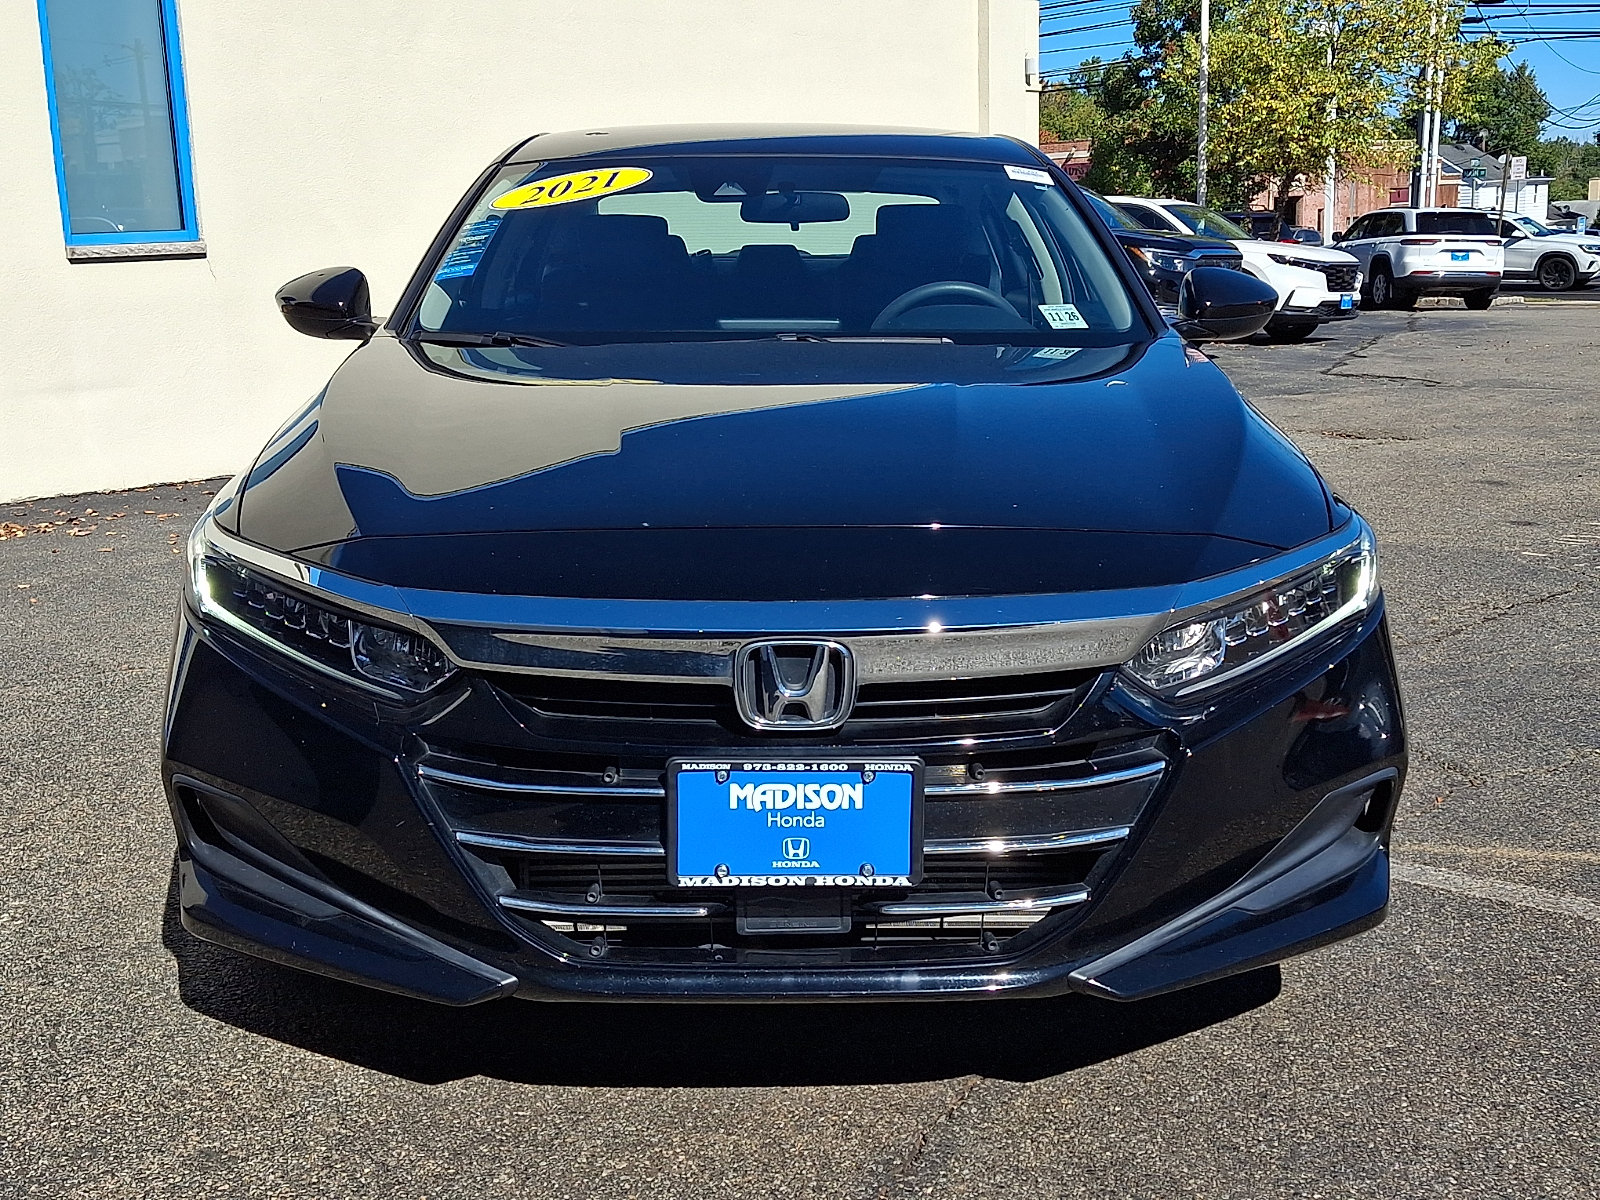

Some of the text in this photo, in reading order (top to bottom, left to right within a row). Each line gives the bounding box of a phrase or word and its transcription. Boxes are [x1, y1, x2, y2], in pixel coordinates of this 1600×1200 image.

[520, 171, 621, 205] 2021
[1048, 311, 1080, 322] 11 26
[864, 763, 914, 772] HONDA
[729, 783, 864, 812] MADISON
[767, 812, 825, 828] Honda
[771, 860, 820, 868] HONDA
[678, 876, 912, 887] MADISON HONDA
